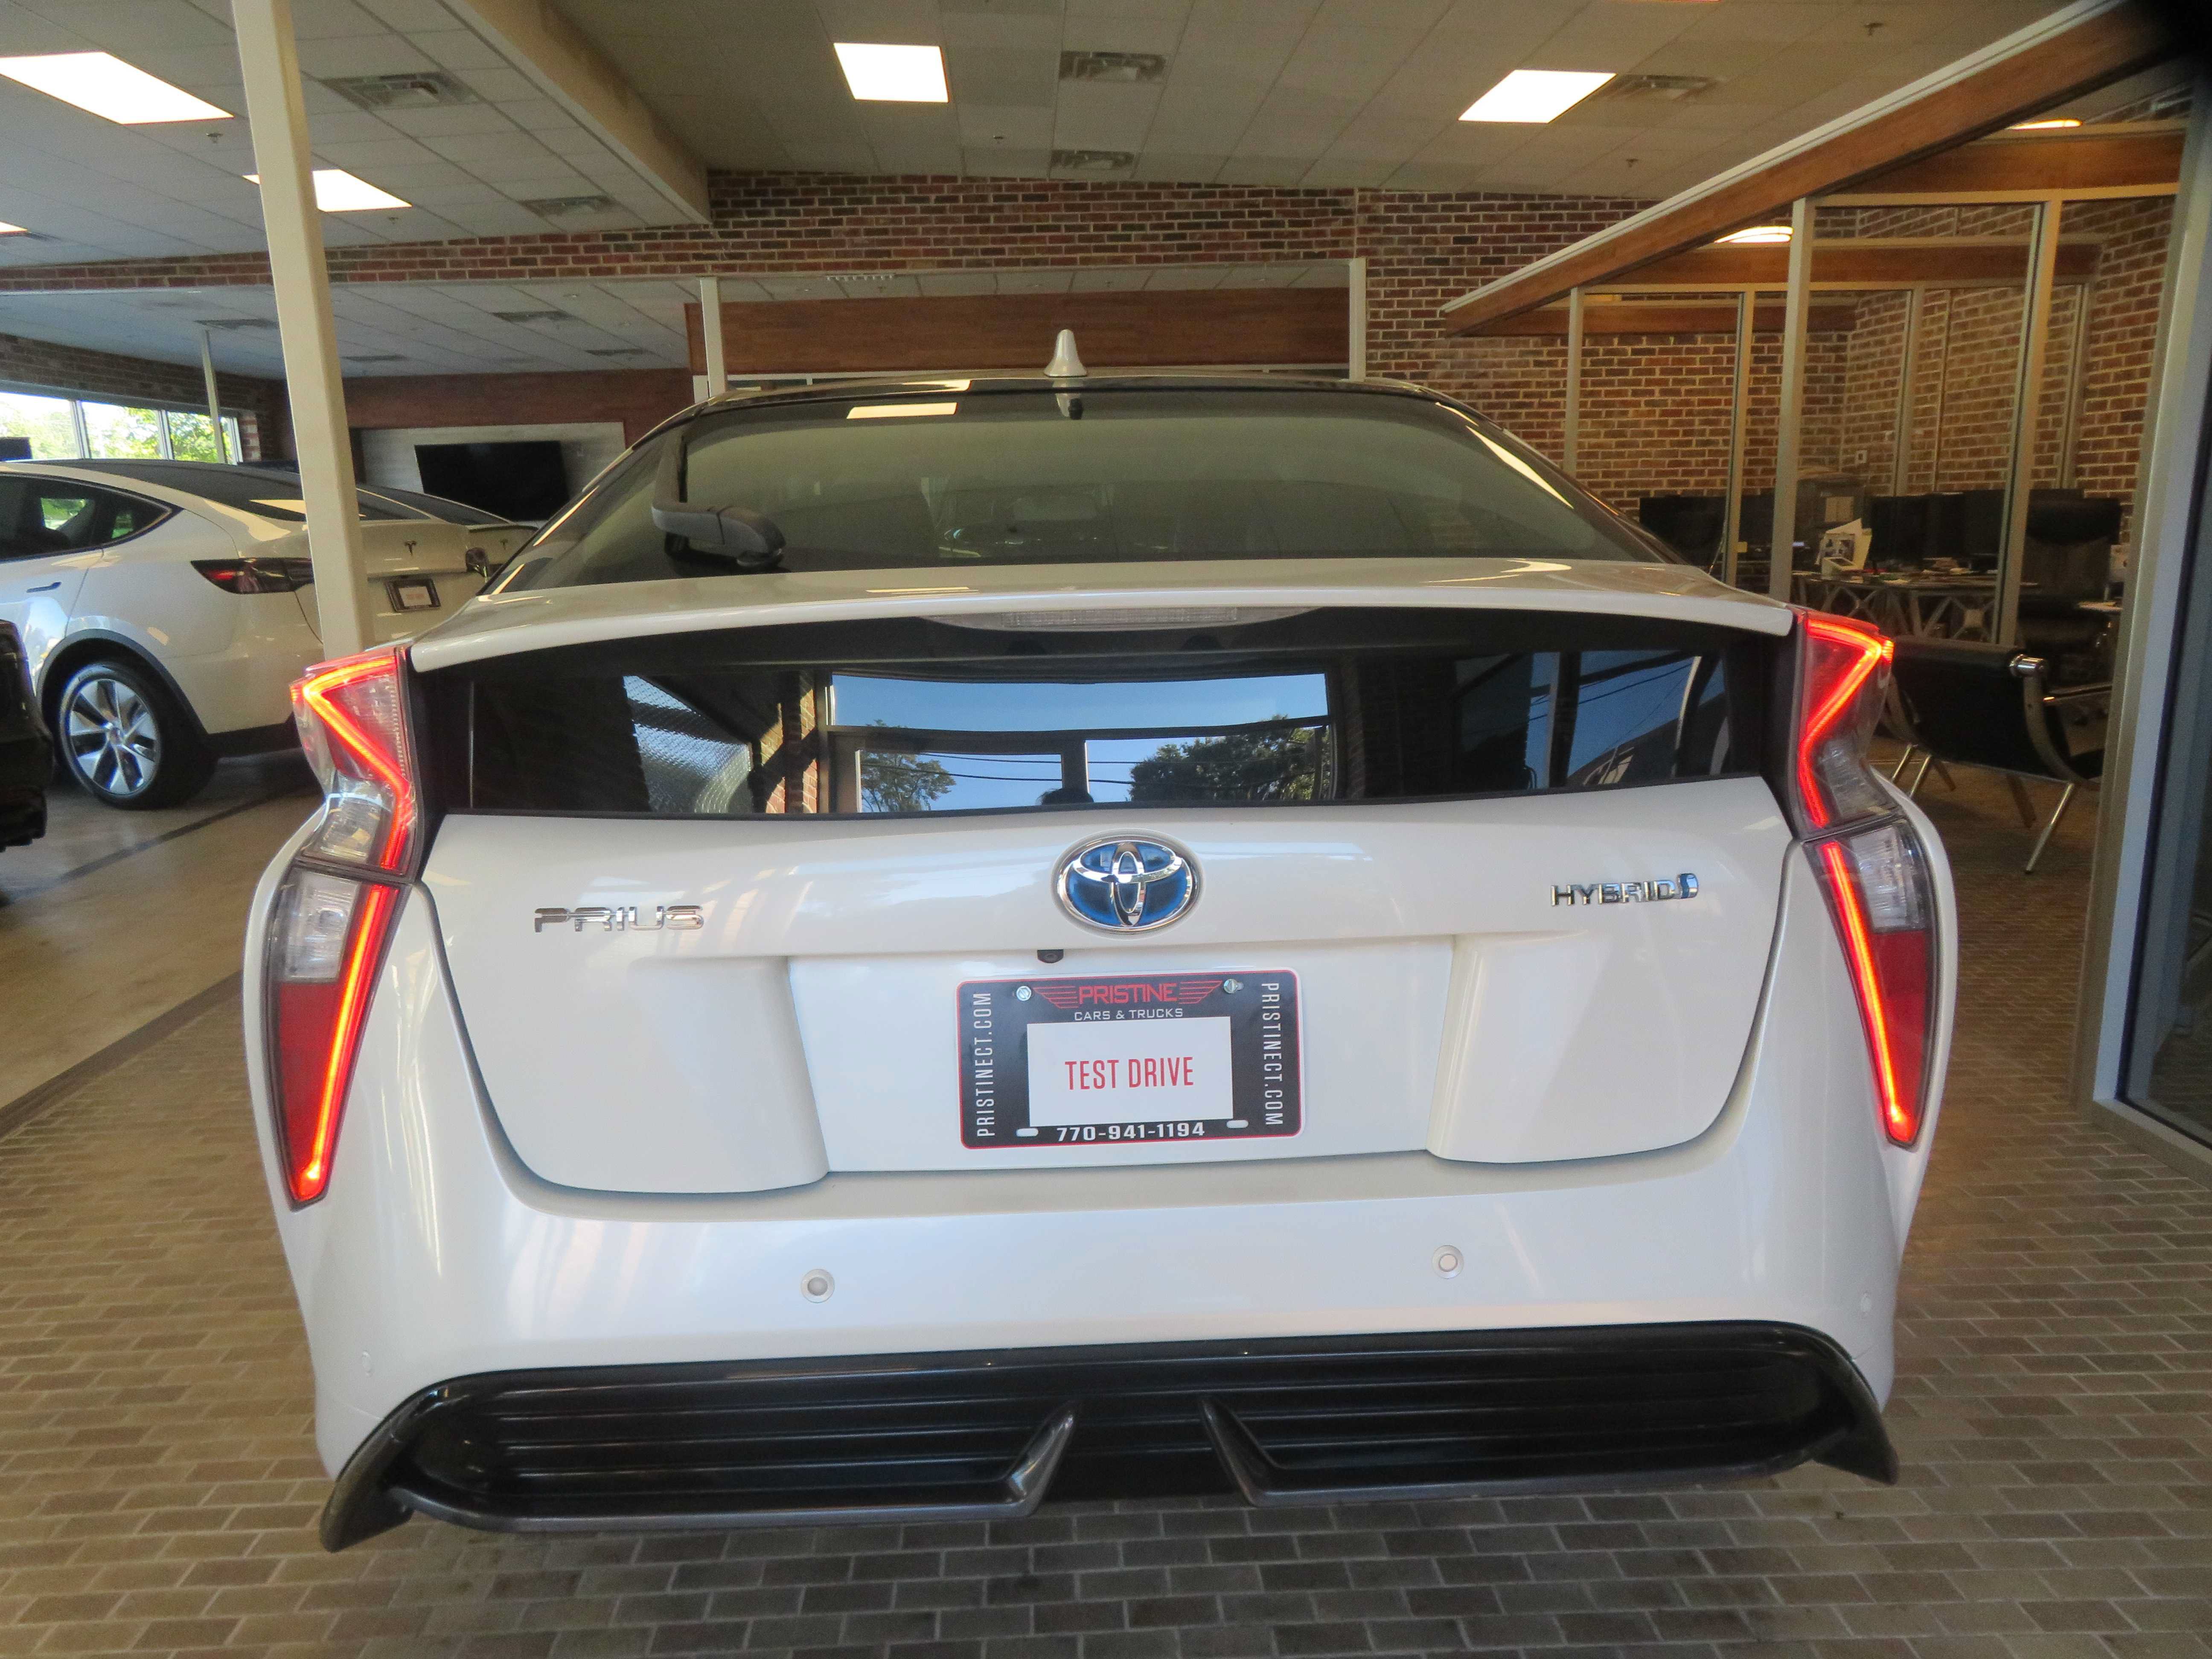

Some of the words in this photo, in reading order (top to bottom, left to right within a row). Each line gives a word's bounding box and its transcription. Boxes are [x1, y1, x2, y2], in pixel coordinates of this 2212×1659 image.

[1550, 880, 1676, 906] HYBRID
[534, 905, 704, 933] PRIUS
[1079, 982, 1179, 1005] PRISTINE
[1074, 1010, 1110, 1021] CARS
[1116, 1010, 1124, 1019] &
[1129, 1008, 1183, 1019] TRUCKS
[974, 992, 995, 1137] PRISTINECT.COM
[1261, 983, 1283, 1126] PRISTINECT.COM
[1065, 1059, 1119, 1090] TEST
[1128, 1056, 1194, 1088] DRIVE
[1057, 1122, 1205, 1142] 770-941-1194
